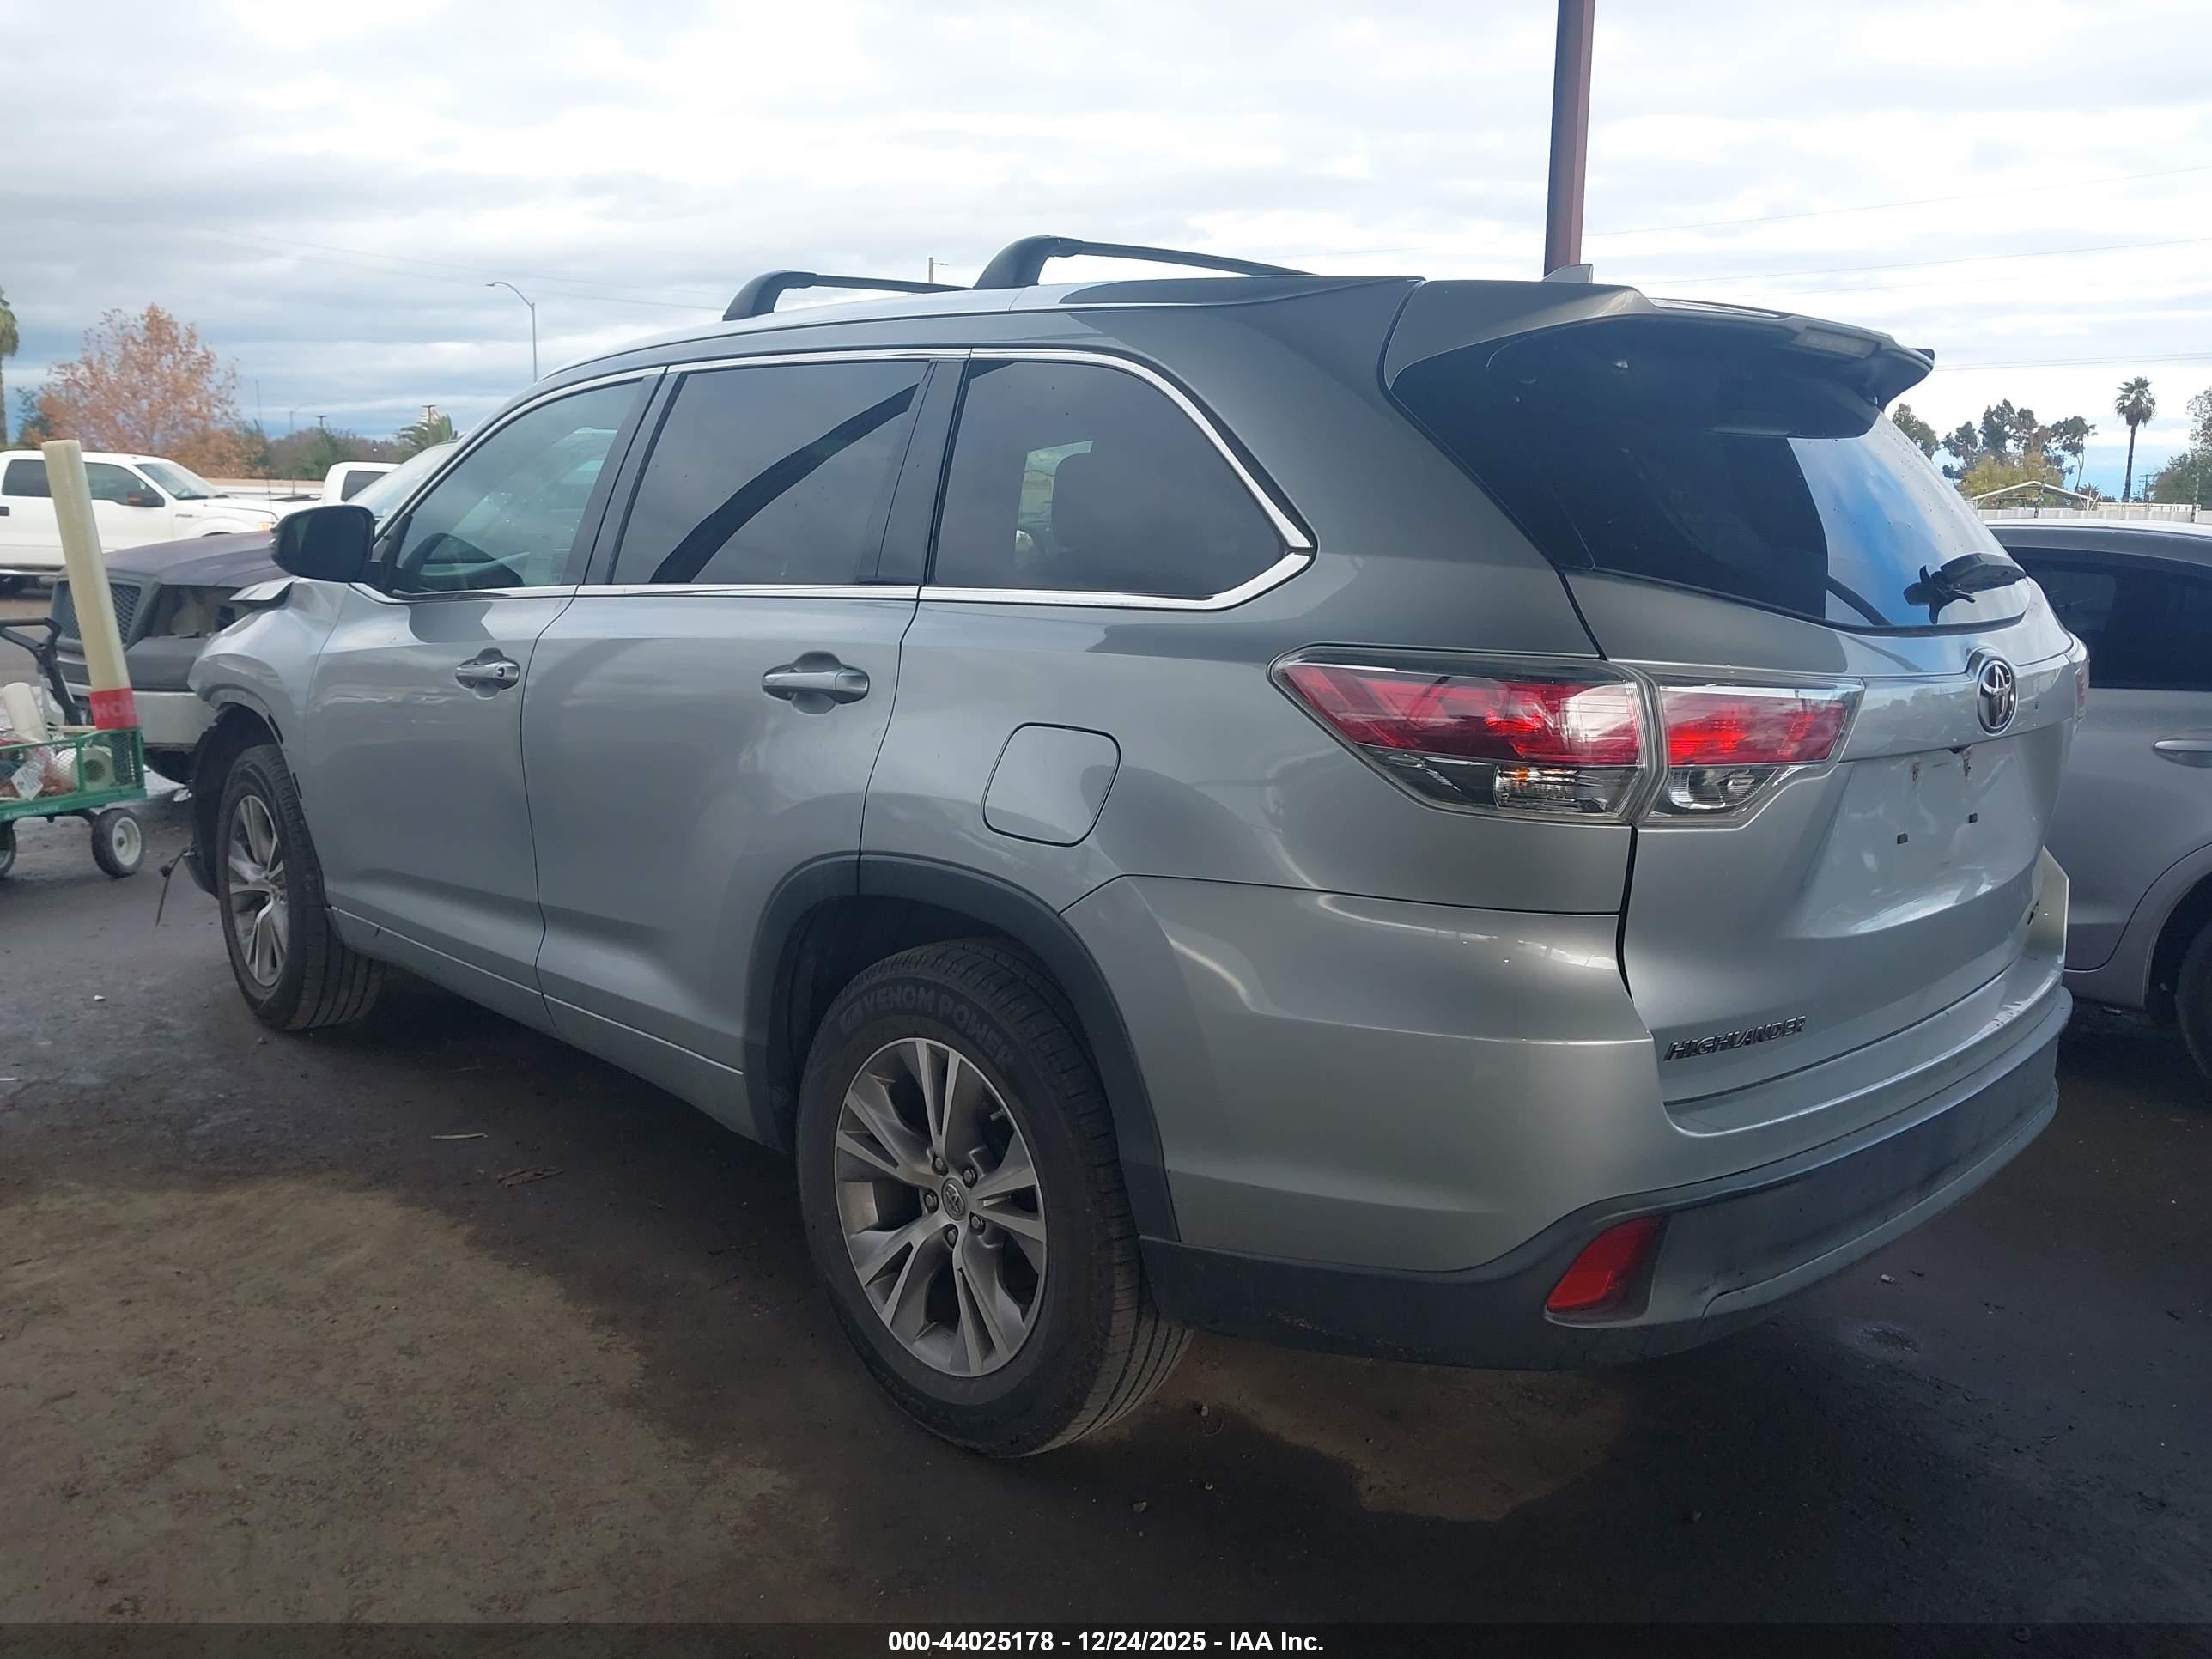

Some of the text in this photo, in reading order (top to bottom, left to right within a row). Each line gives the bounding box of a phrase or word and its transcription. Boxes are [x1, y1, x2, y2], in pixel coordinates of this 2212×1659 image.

[862, 985, 1014, 1066] VENOM POWER
[1662, 1015, 1807, 1061] HIGHLANDER
